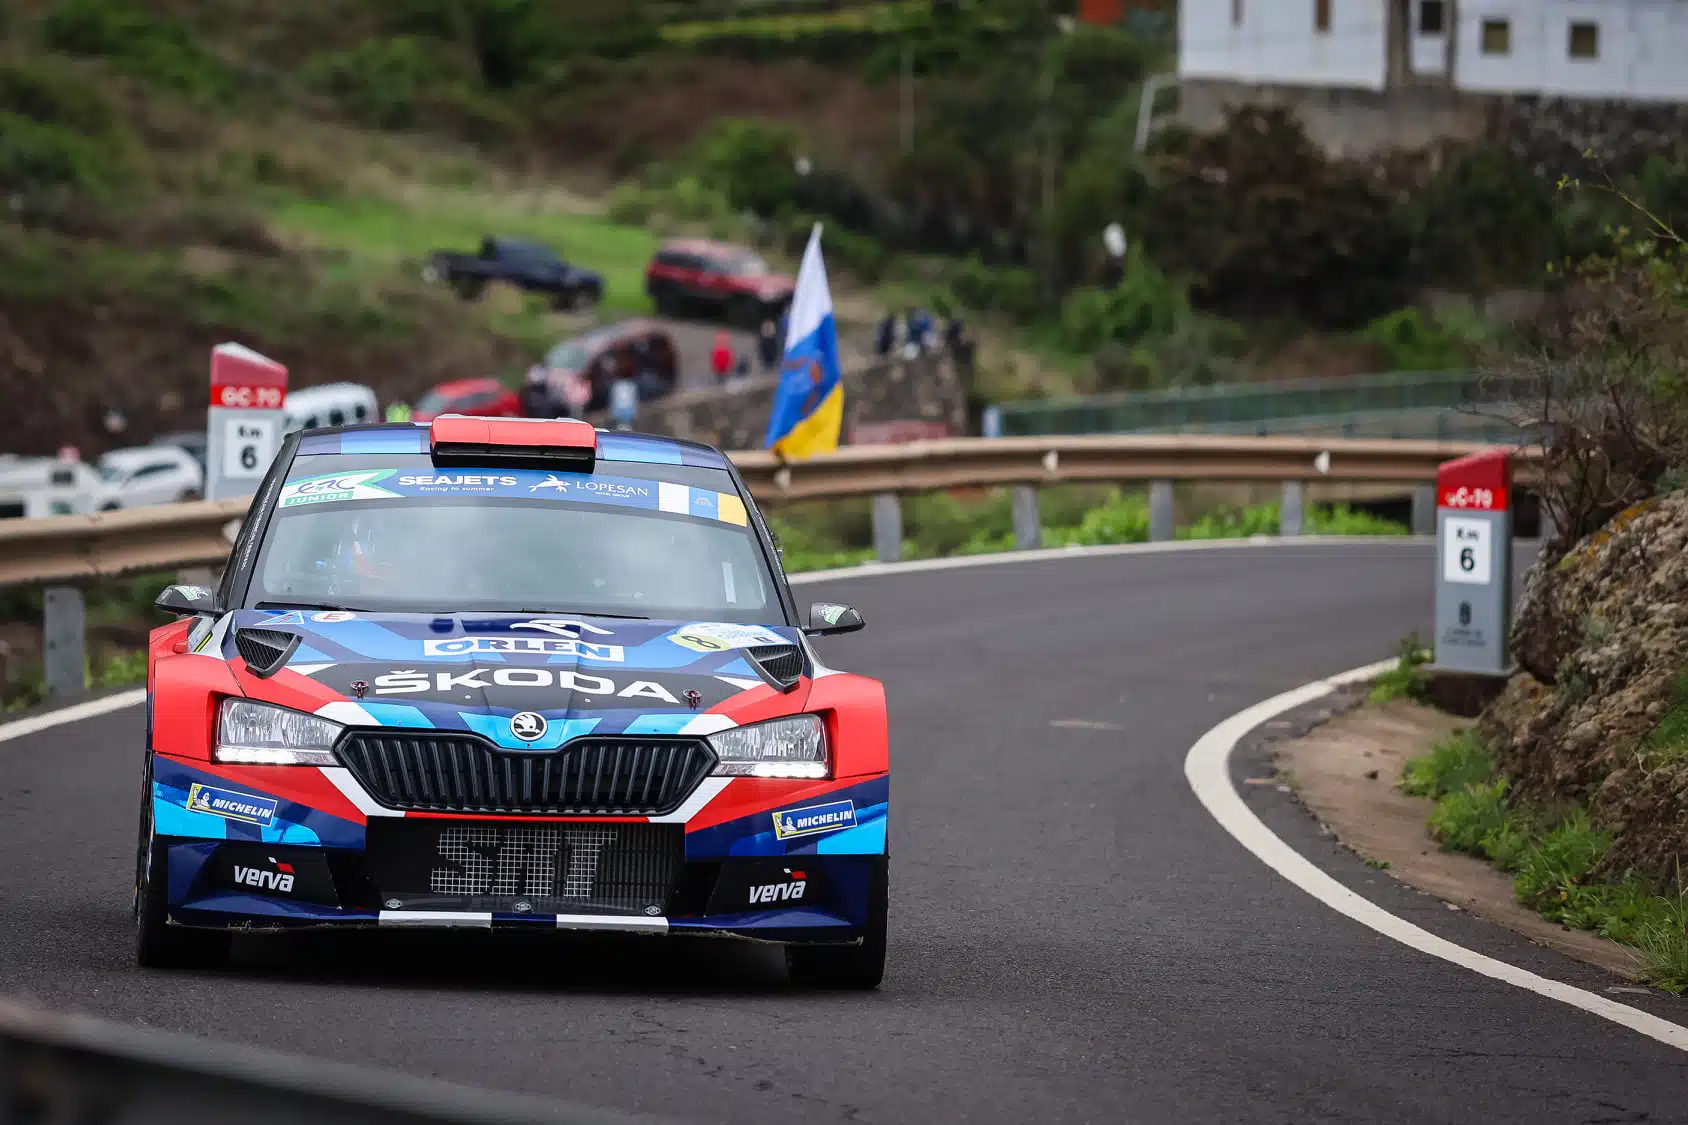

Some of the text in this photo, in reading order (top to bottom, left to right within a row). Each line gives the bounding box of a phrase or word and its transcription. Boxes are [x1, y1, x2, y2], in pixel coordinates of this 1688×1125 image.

[241, 445, 258, 469] 6
[398, 475, 518, 486] SEAJETS
[576, 480, 649, 497] LOPESAN
[288, 491, 350, 505] JUNIOR
[1460, 548, 1475, 572] 6
[435, 639, 610, 658] ORLEN
[374, 669, 680, 704] ŠKODA
[212, 798, 272, 818] MICHELIN
[797, 810, 852, 828] MICHELIN
